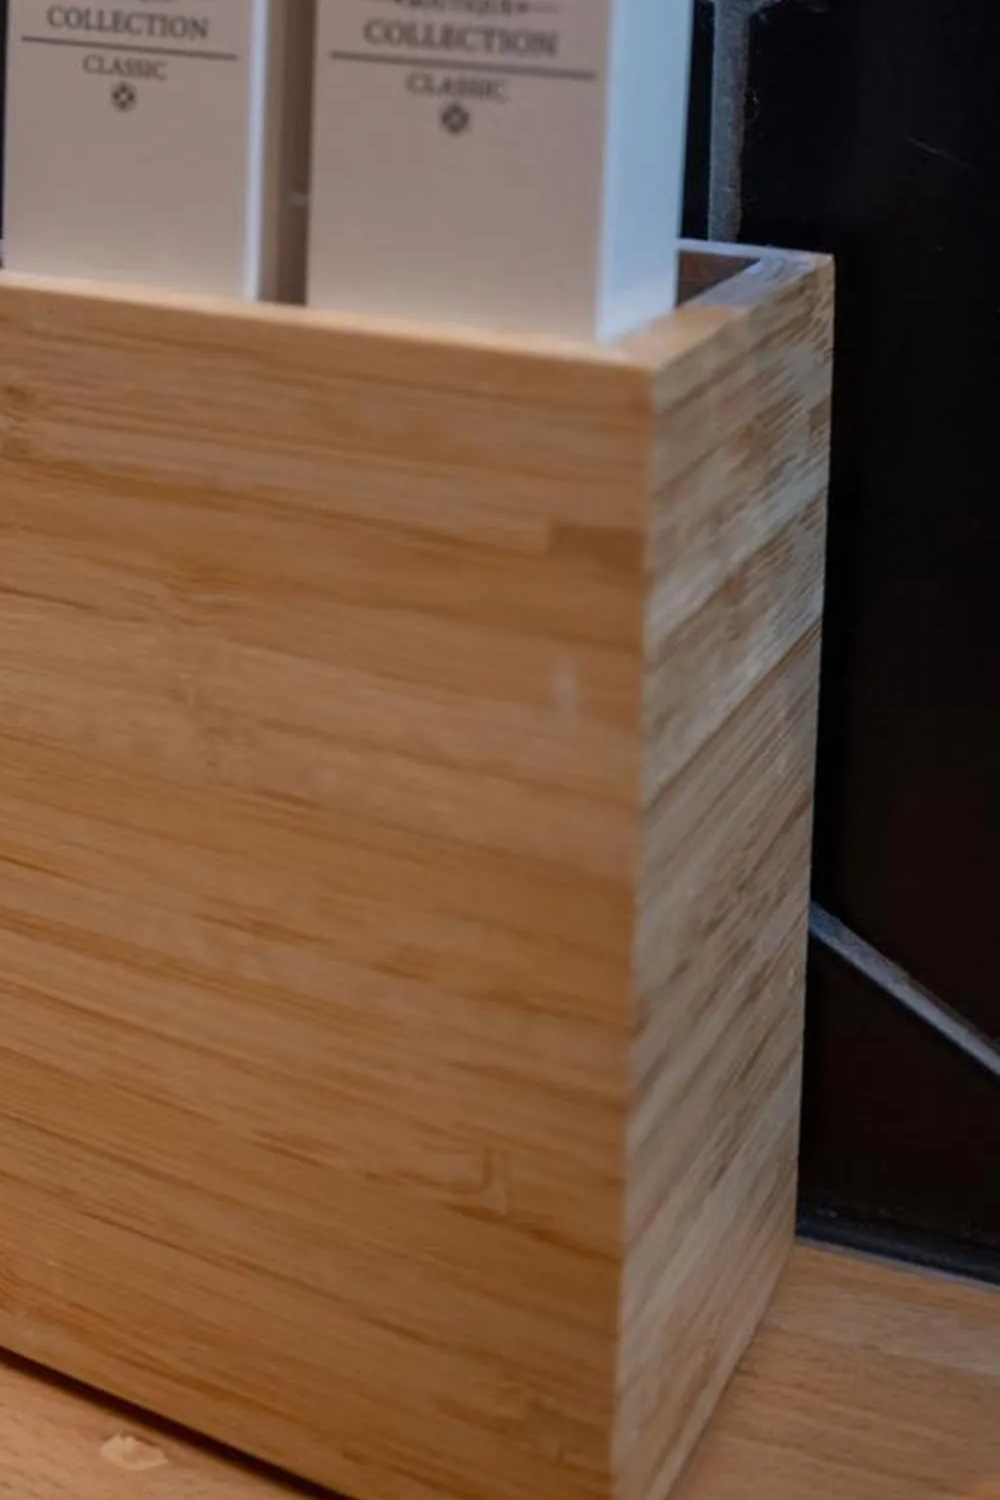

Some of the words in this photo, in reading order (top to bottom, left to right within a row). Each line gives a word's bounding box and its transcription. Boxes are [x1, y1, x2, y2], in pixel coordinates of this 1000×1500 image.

[47, 5, 209, 39] COLLECTION
[363, 18, 558, 57] COLLECTION
[83, 54, 168, 81] CLASSIC
[405, 71, 512, 104] CLASSIC
